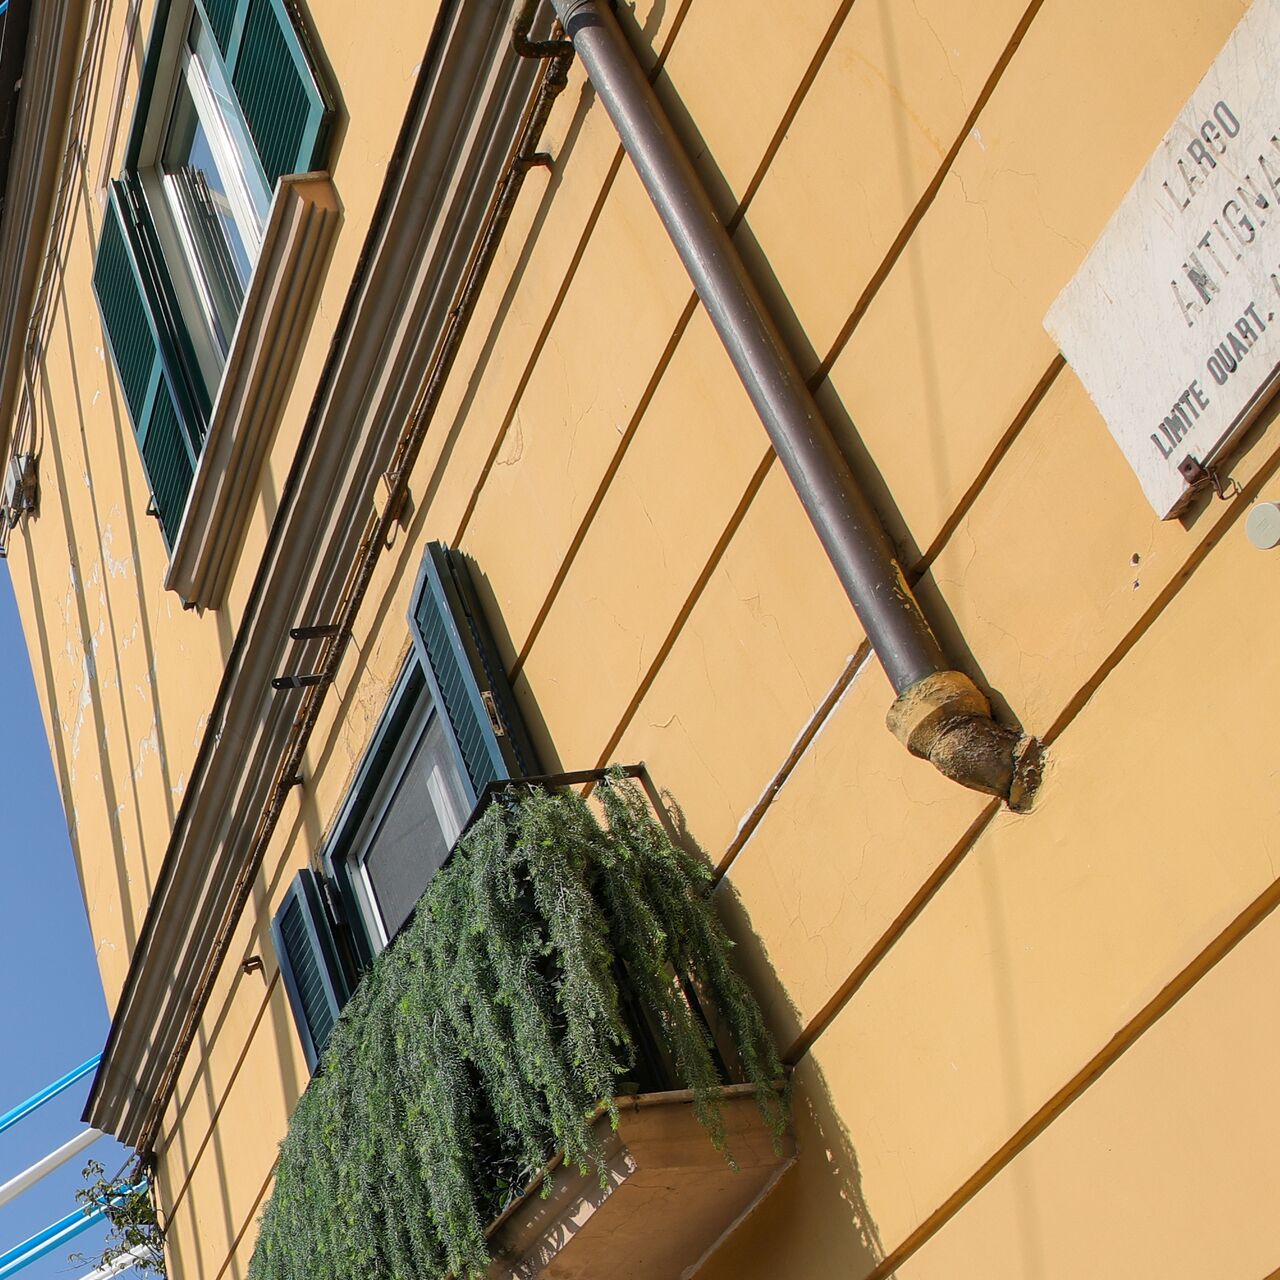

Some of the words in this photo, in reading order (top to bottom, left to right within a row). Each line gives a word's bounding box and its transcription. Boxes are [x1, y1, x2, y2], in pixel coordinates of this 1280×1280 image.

[1163, 100, 1241, 214] LARGO
[1170, 128, 1280, 328] ANTIGNA
[1150, 379, 1210, 460] LIMITE
[1206, 301, 1275, 387] QUART.
